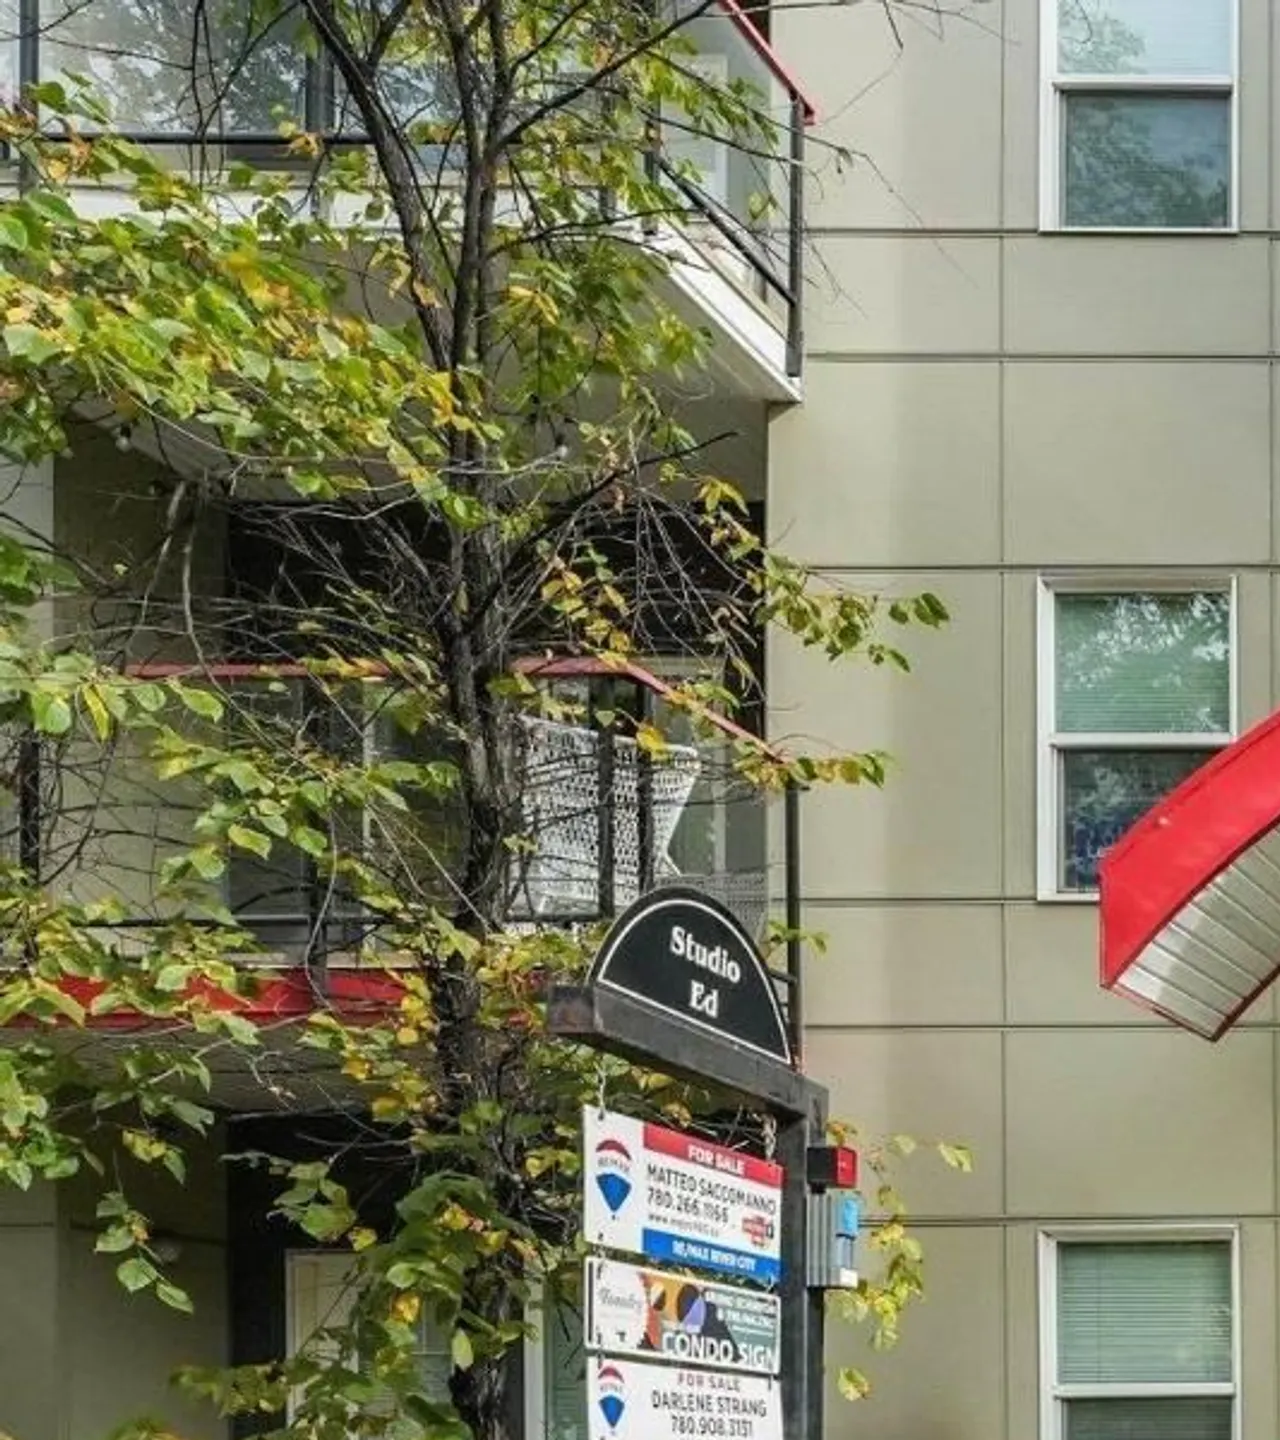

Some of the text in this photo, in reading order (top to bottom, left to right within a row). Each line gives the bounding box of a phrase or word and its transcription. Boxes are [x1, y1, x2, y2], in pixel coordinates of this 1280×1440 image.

[670, 926, 741, 984] Studio
[689, 980, 719, 1018] Ed
[687, 1145, 745, 1175] FOR SALE
[647, 1164, 697, 1192] MATTEO
[662, 1331, 774, 1368] CONDO SIGN
[677, 1372, 741, 1392] FOR SALE
[651, 1389, 767, 1417] DARLENE STRANG
